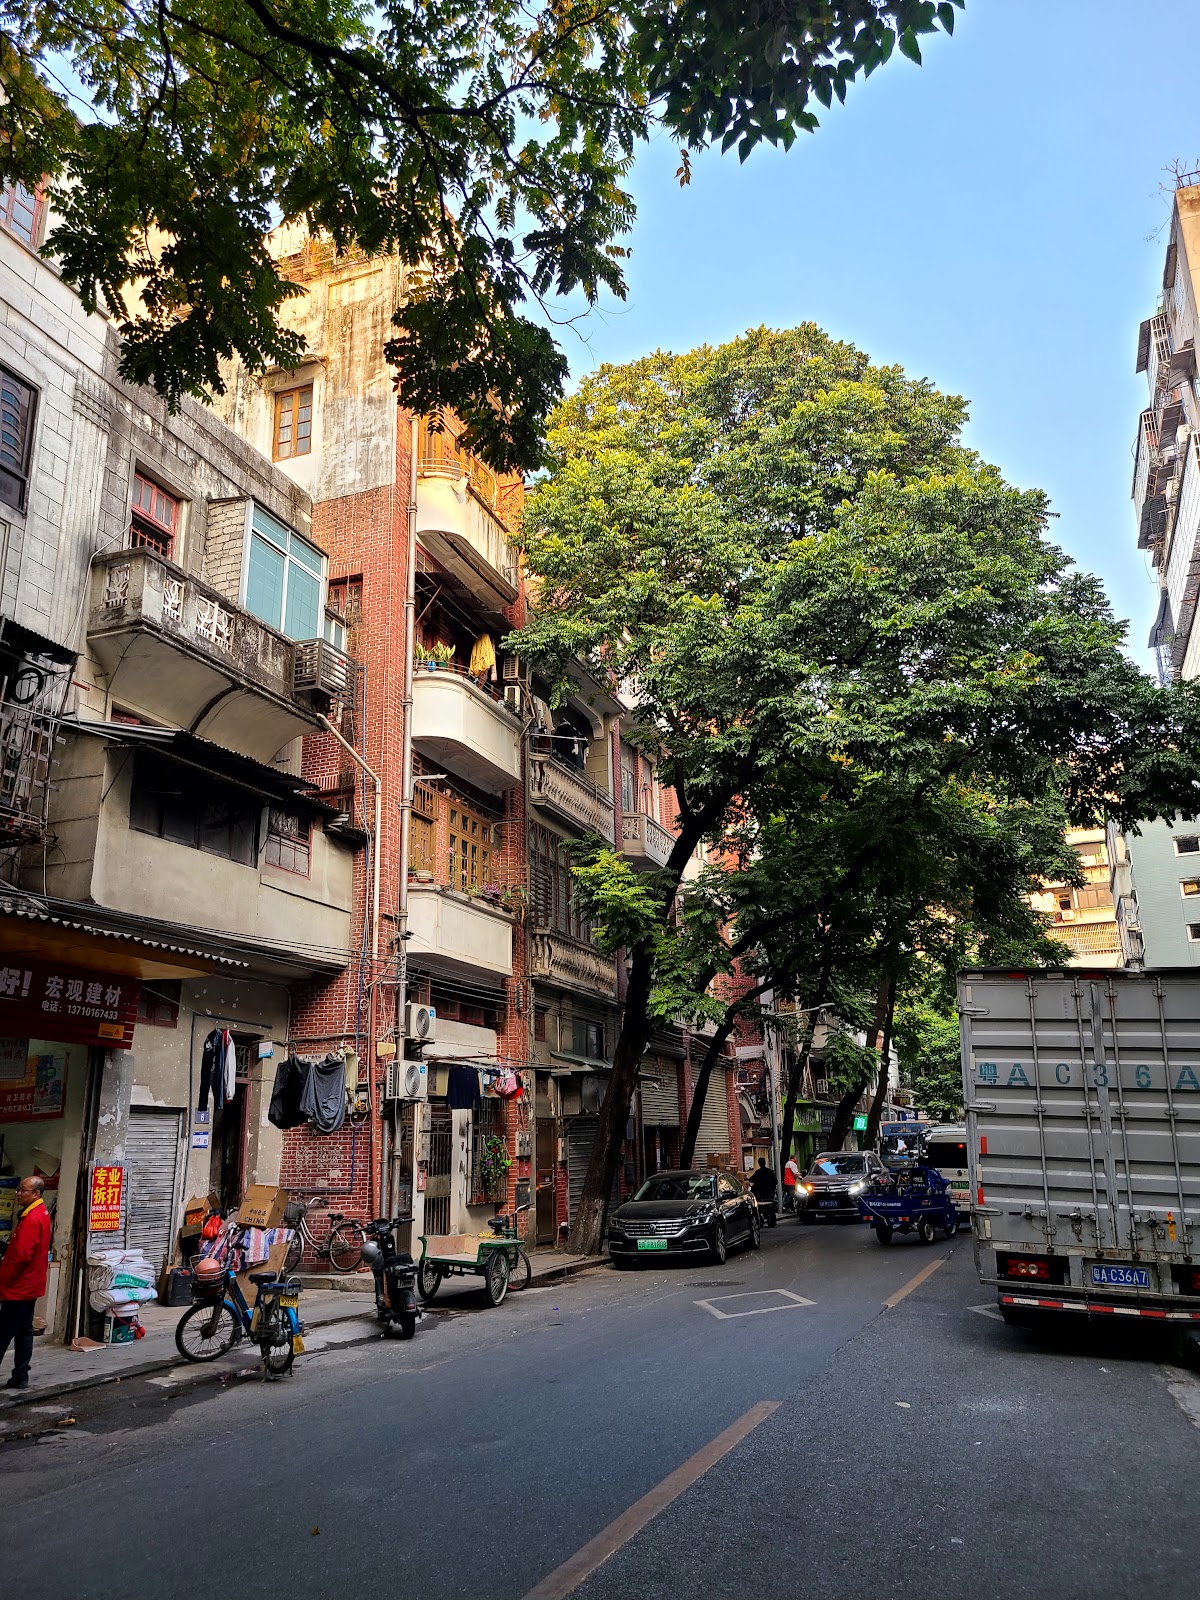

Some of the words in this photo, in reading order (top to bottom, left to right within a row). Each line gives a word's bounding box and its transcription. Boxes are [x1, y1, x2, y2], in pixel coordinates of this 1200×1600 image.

[45, 976, 122, 1008] 宏观建材
[67, 1005, 118, 1020] 13710167433
[95, 1167, 120, 1186] 专业
[93, 1186, 120, 1205] 拆打
[244, 1216, 265, 1225] CHINA
